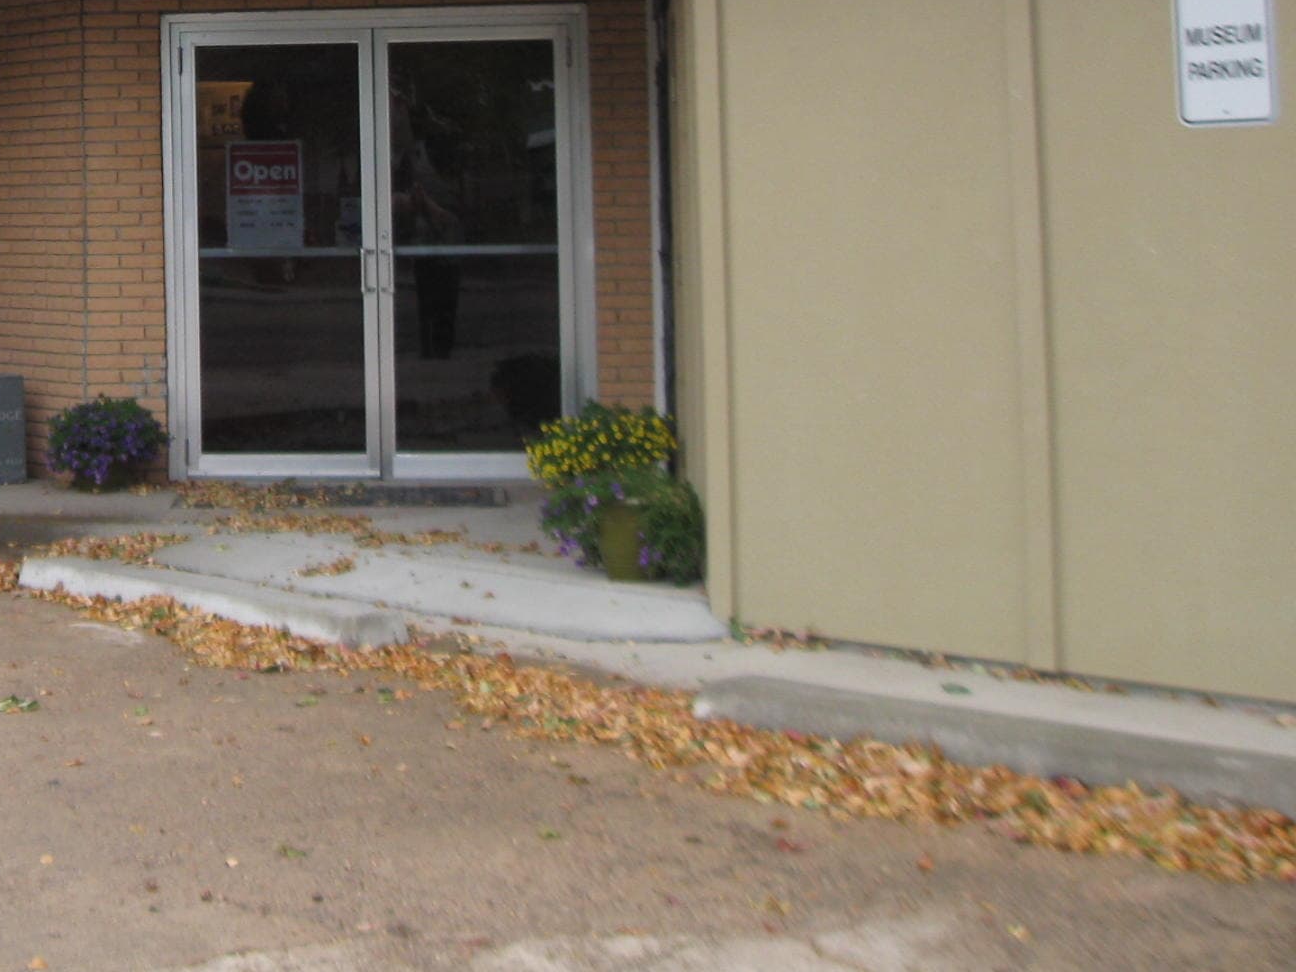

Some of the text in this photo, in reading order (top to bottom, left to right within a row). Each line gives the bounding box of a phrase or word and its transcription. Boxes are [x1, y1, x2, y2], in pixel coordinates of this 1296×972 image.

[1185, 23, 1262, 46] MUSEUM
[1188, 58, 1263, 80] PARKING
[233, 159, 297, 185] Open
